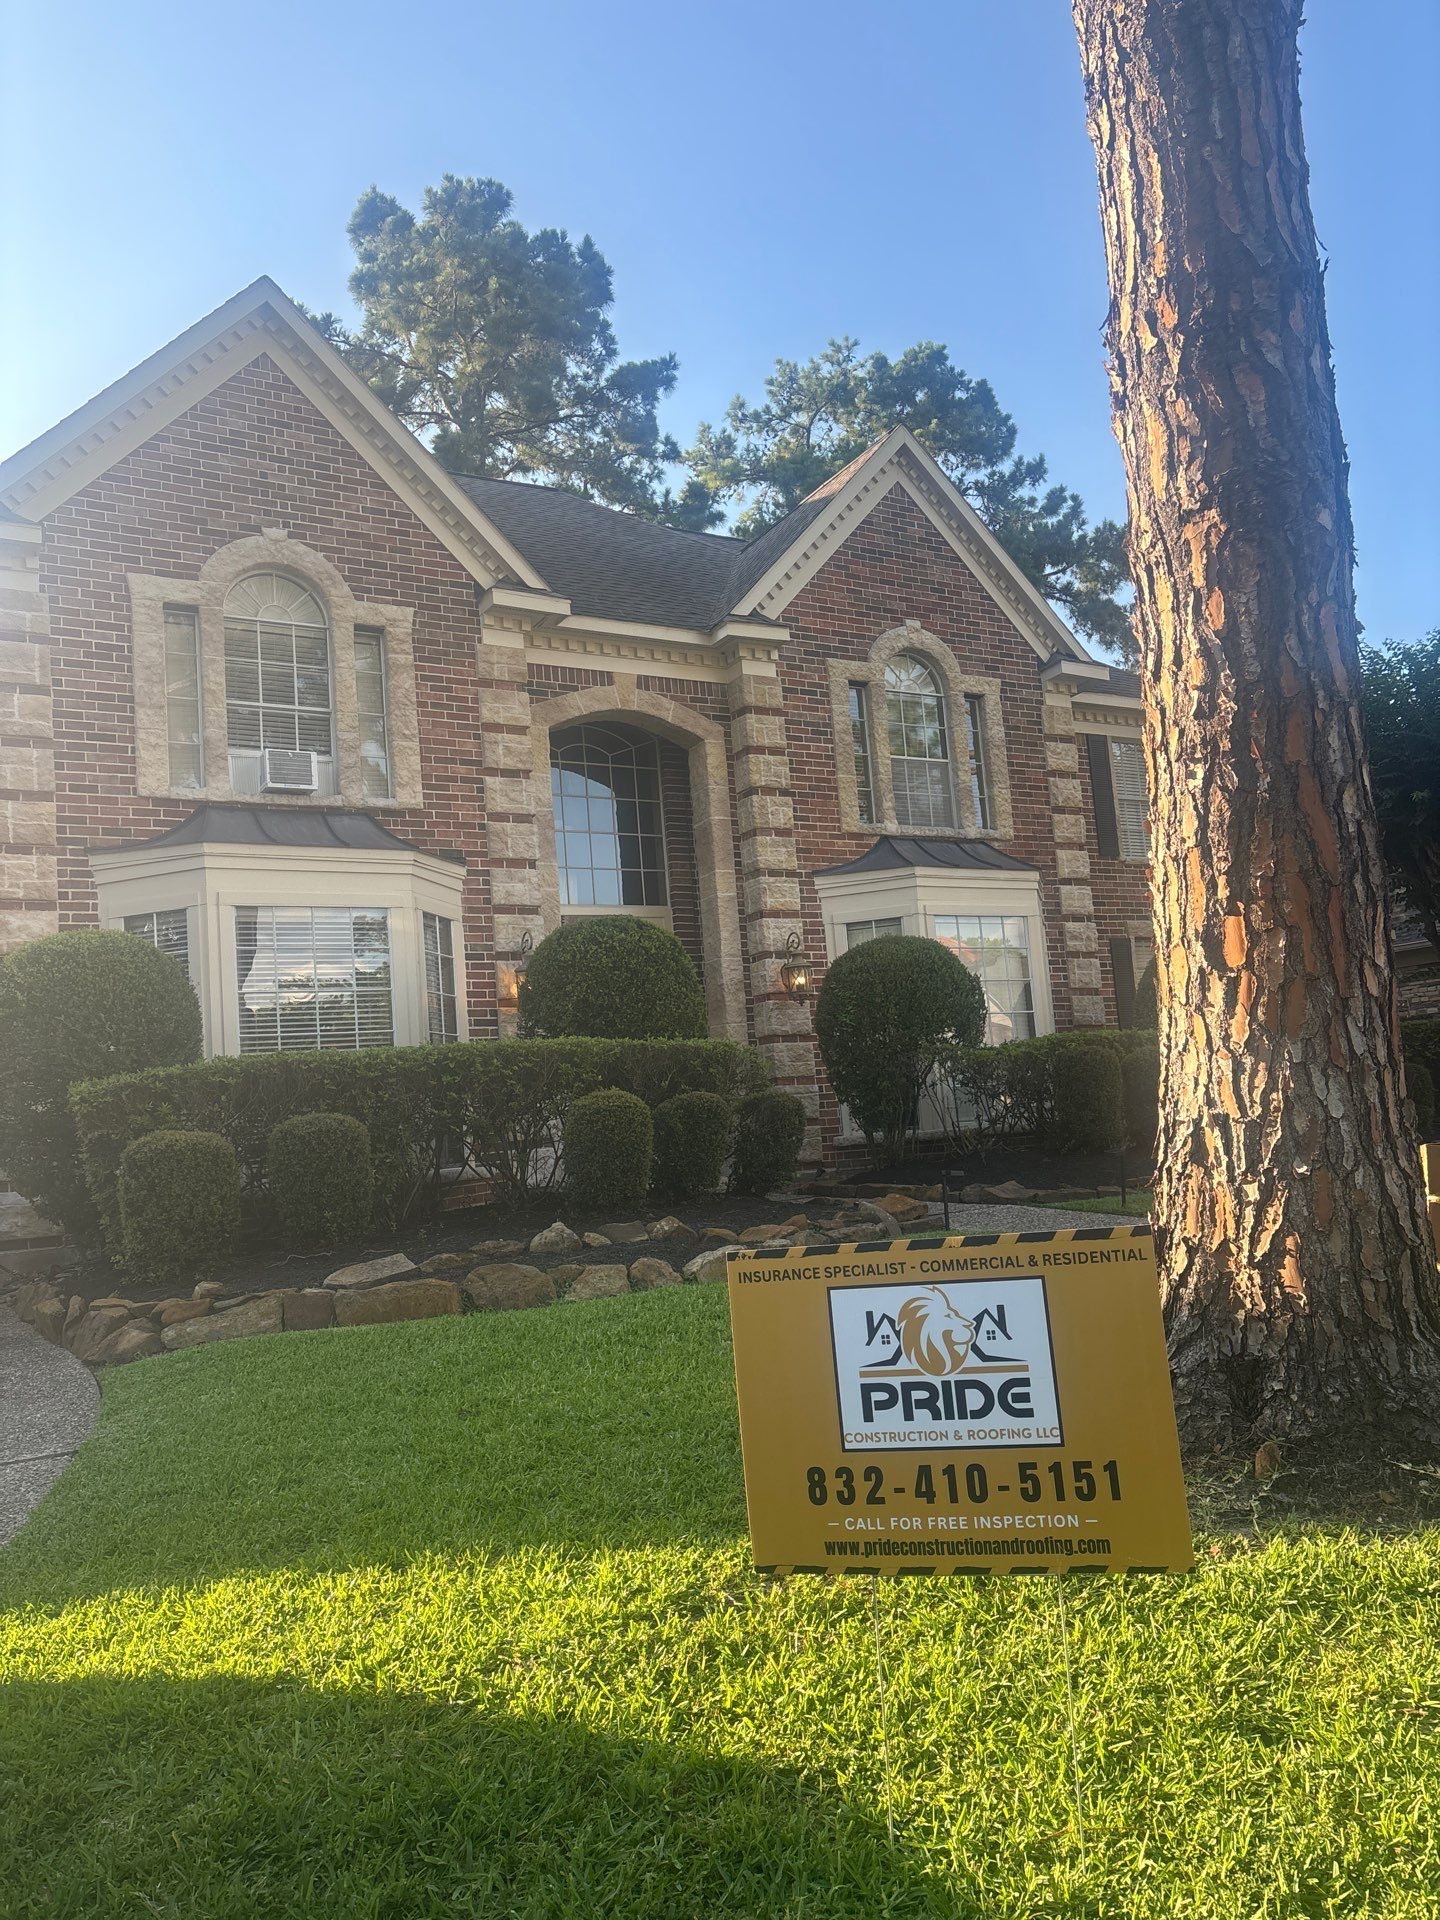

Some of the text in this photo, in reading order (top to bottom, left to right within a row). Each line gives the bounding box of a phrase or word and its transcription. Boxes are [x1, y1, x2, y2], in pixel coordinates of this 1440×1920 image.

[738, 1267, 821, 1284] INSURANCE
[824, 1262, 907, 1278] SPECIALIST
[919, 1255, 1024, 1273] COMMERCIAL
[1028, 1254, 1039, 1267] &
[1043, 1248, 1148, 1266] RESIDENTIAL
[860, 1377, 1035, 1423] PRIDE
[844, 1426, 1060, 1444] CONSTRUCTION & ROOFING LLC
[806, 1460, 1122, 1506] 832-410-5151
[844, 1514, 1080, 1530] CALL FOR FREE INSPECTION
[824, 1536, 1112, 1558] www.prideconstructionandroofing.com
